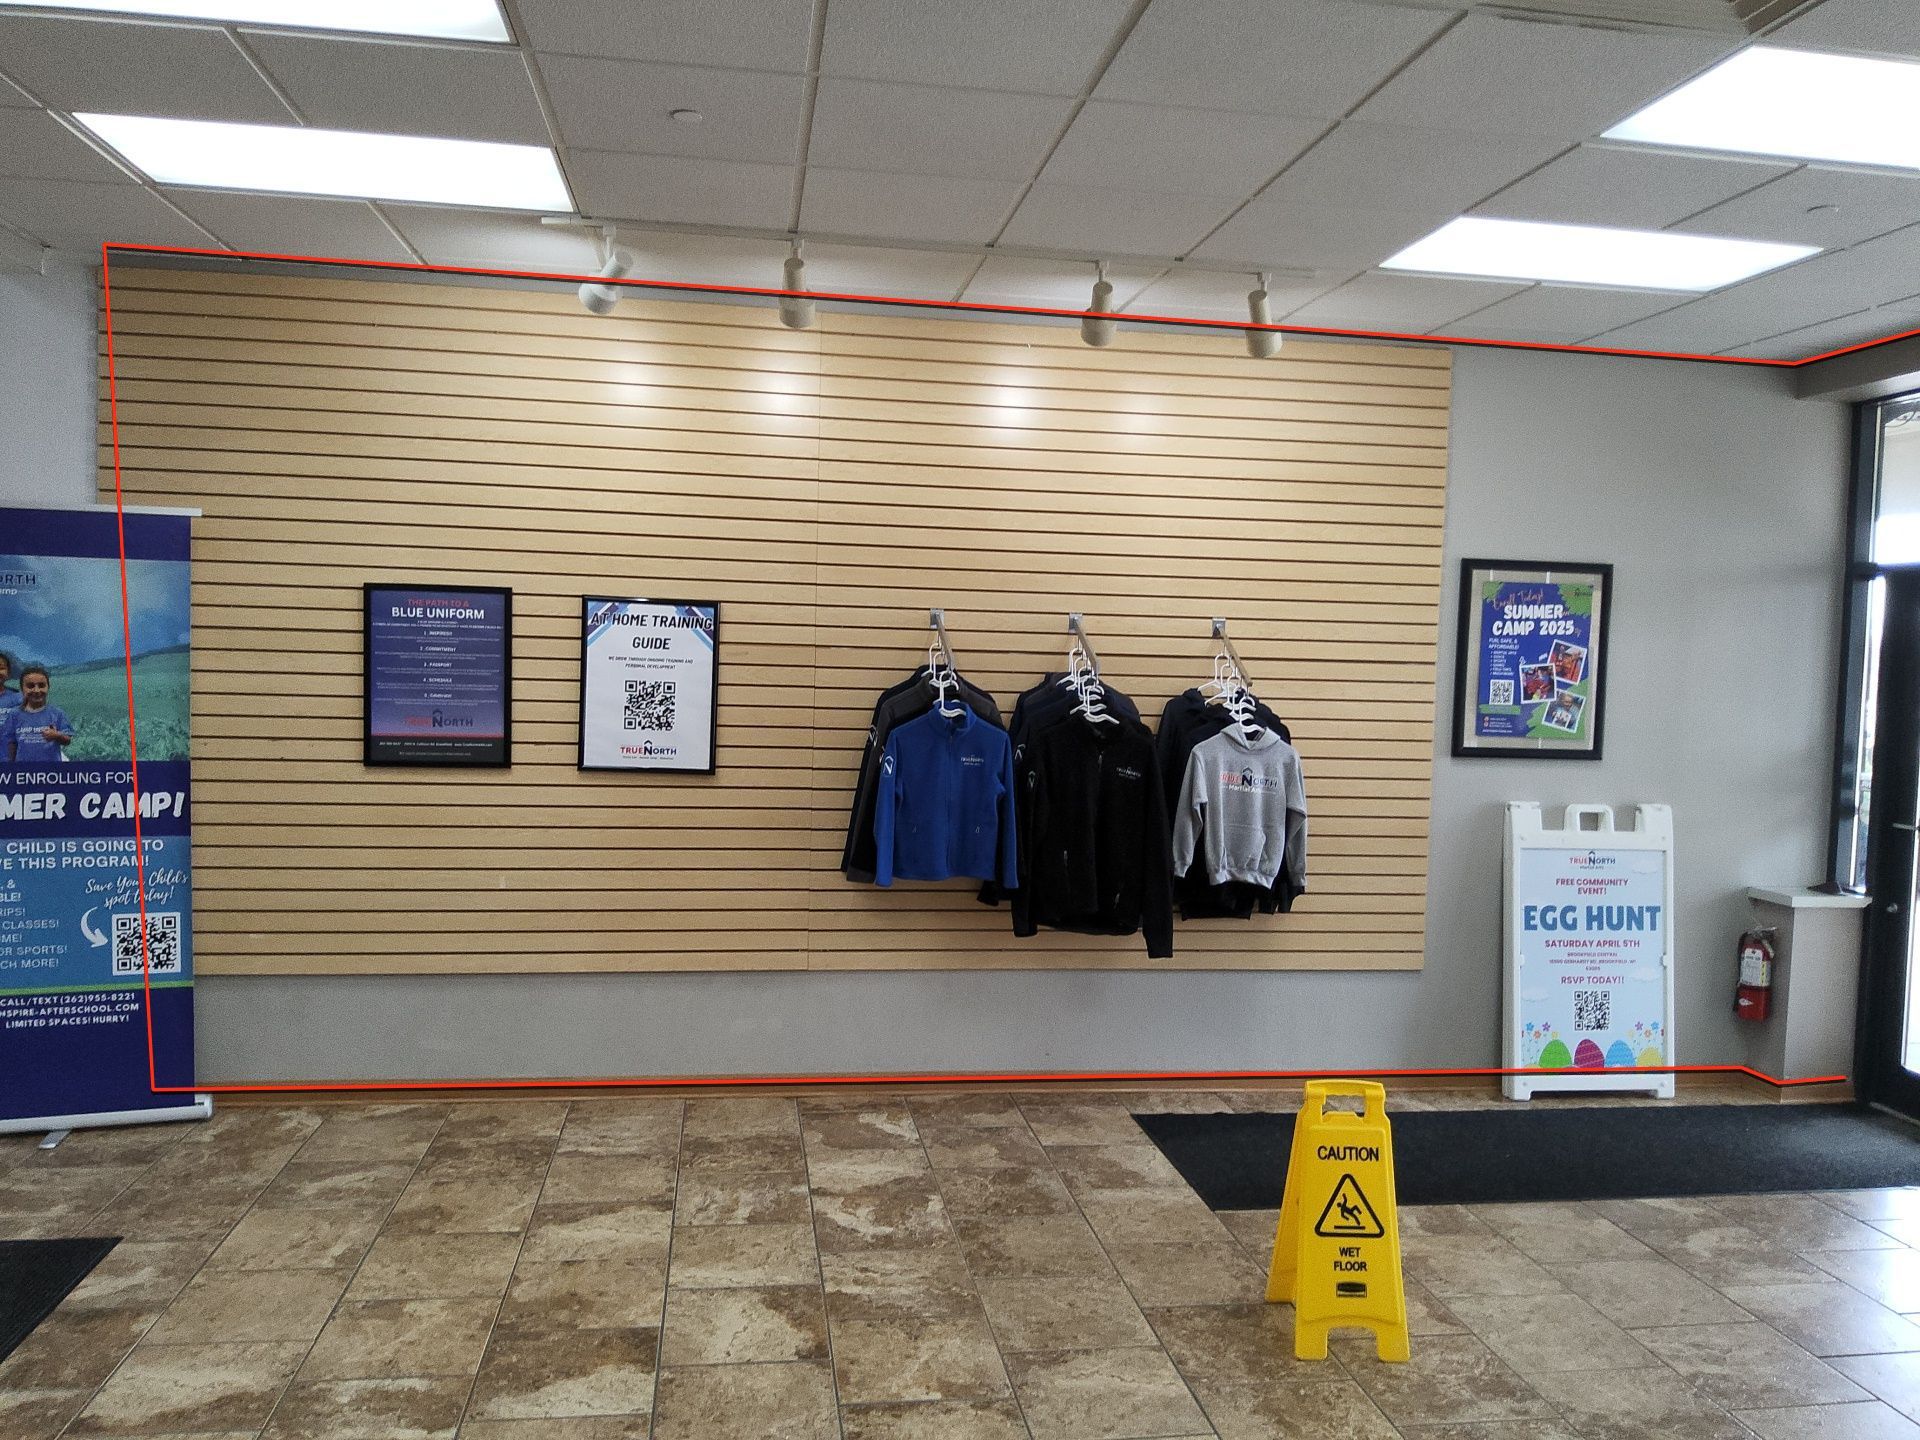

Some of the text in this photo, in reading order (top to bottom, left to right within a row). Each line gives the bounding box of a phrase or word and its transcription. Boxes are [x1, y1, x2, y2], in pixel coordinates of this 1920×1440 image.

[392, 606, 485, 619] BLUE UNIFORM
[1503, 604, 1564, 620] SUMMER
[591, 612, 713, 630] AT HOME TRAINING
[1492, 620, 1535, 636] CAMP
[1539, 620, 1575, 636] 2025
[632, 636, 671, 650] GUIDE
[16, 771, 101, 785] ENROLLING
[105, 771, 135, 784] FOR
[79, 791, 186, 820] CAMP!
[6, 839, 164, 855] CHILD IS GOING TO
[18, 857, 56, 869] THIS
[62, 855, 149, 868] PROGRAM!
[85, 878, 114, 894] Save
[116, 876, 145, 894] You
[1555, 878, 1628, 887] FREE COMMUNITY
[103, 886, 175, 910] spot tday!
[1577, 887, 1607, 895] EVENT!
[2, 918, 60, 930] CLASSES!
[1523, 904, 1661, 931] EGG HUNT
[17, 945, 68, 955] SPORTS!
[1545, 939, 1640, 948] SATURDAY APRIL 5TH
[21, 958, 59, 968] MORE!
[1561, 976, 1625, 985] RSVP TODAY!!
[0, 996, 57, 1007] CALL/TEXT
[5, 1014, 130, 1029] LIMITED SPACES! HURRY!
[1317, 1145, 1379, 1162] CAUTION
[1339, 1246, 1361, 1258] WET
[1333, 1261, 1367, 1272] FLOOR
